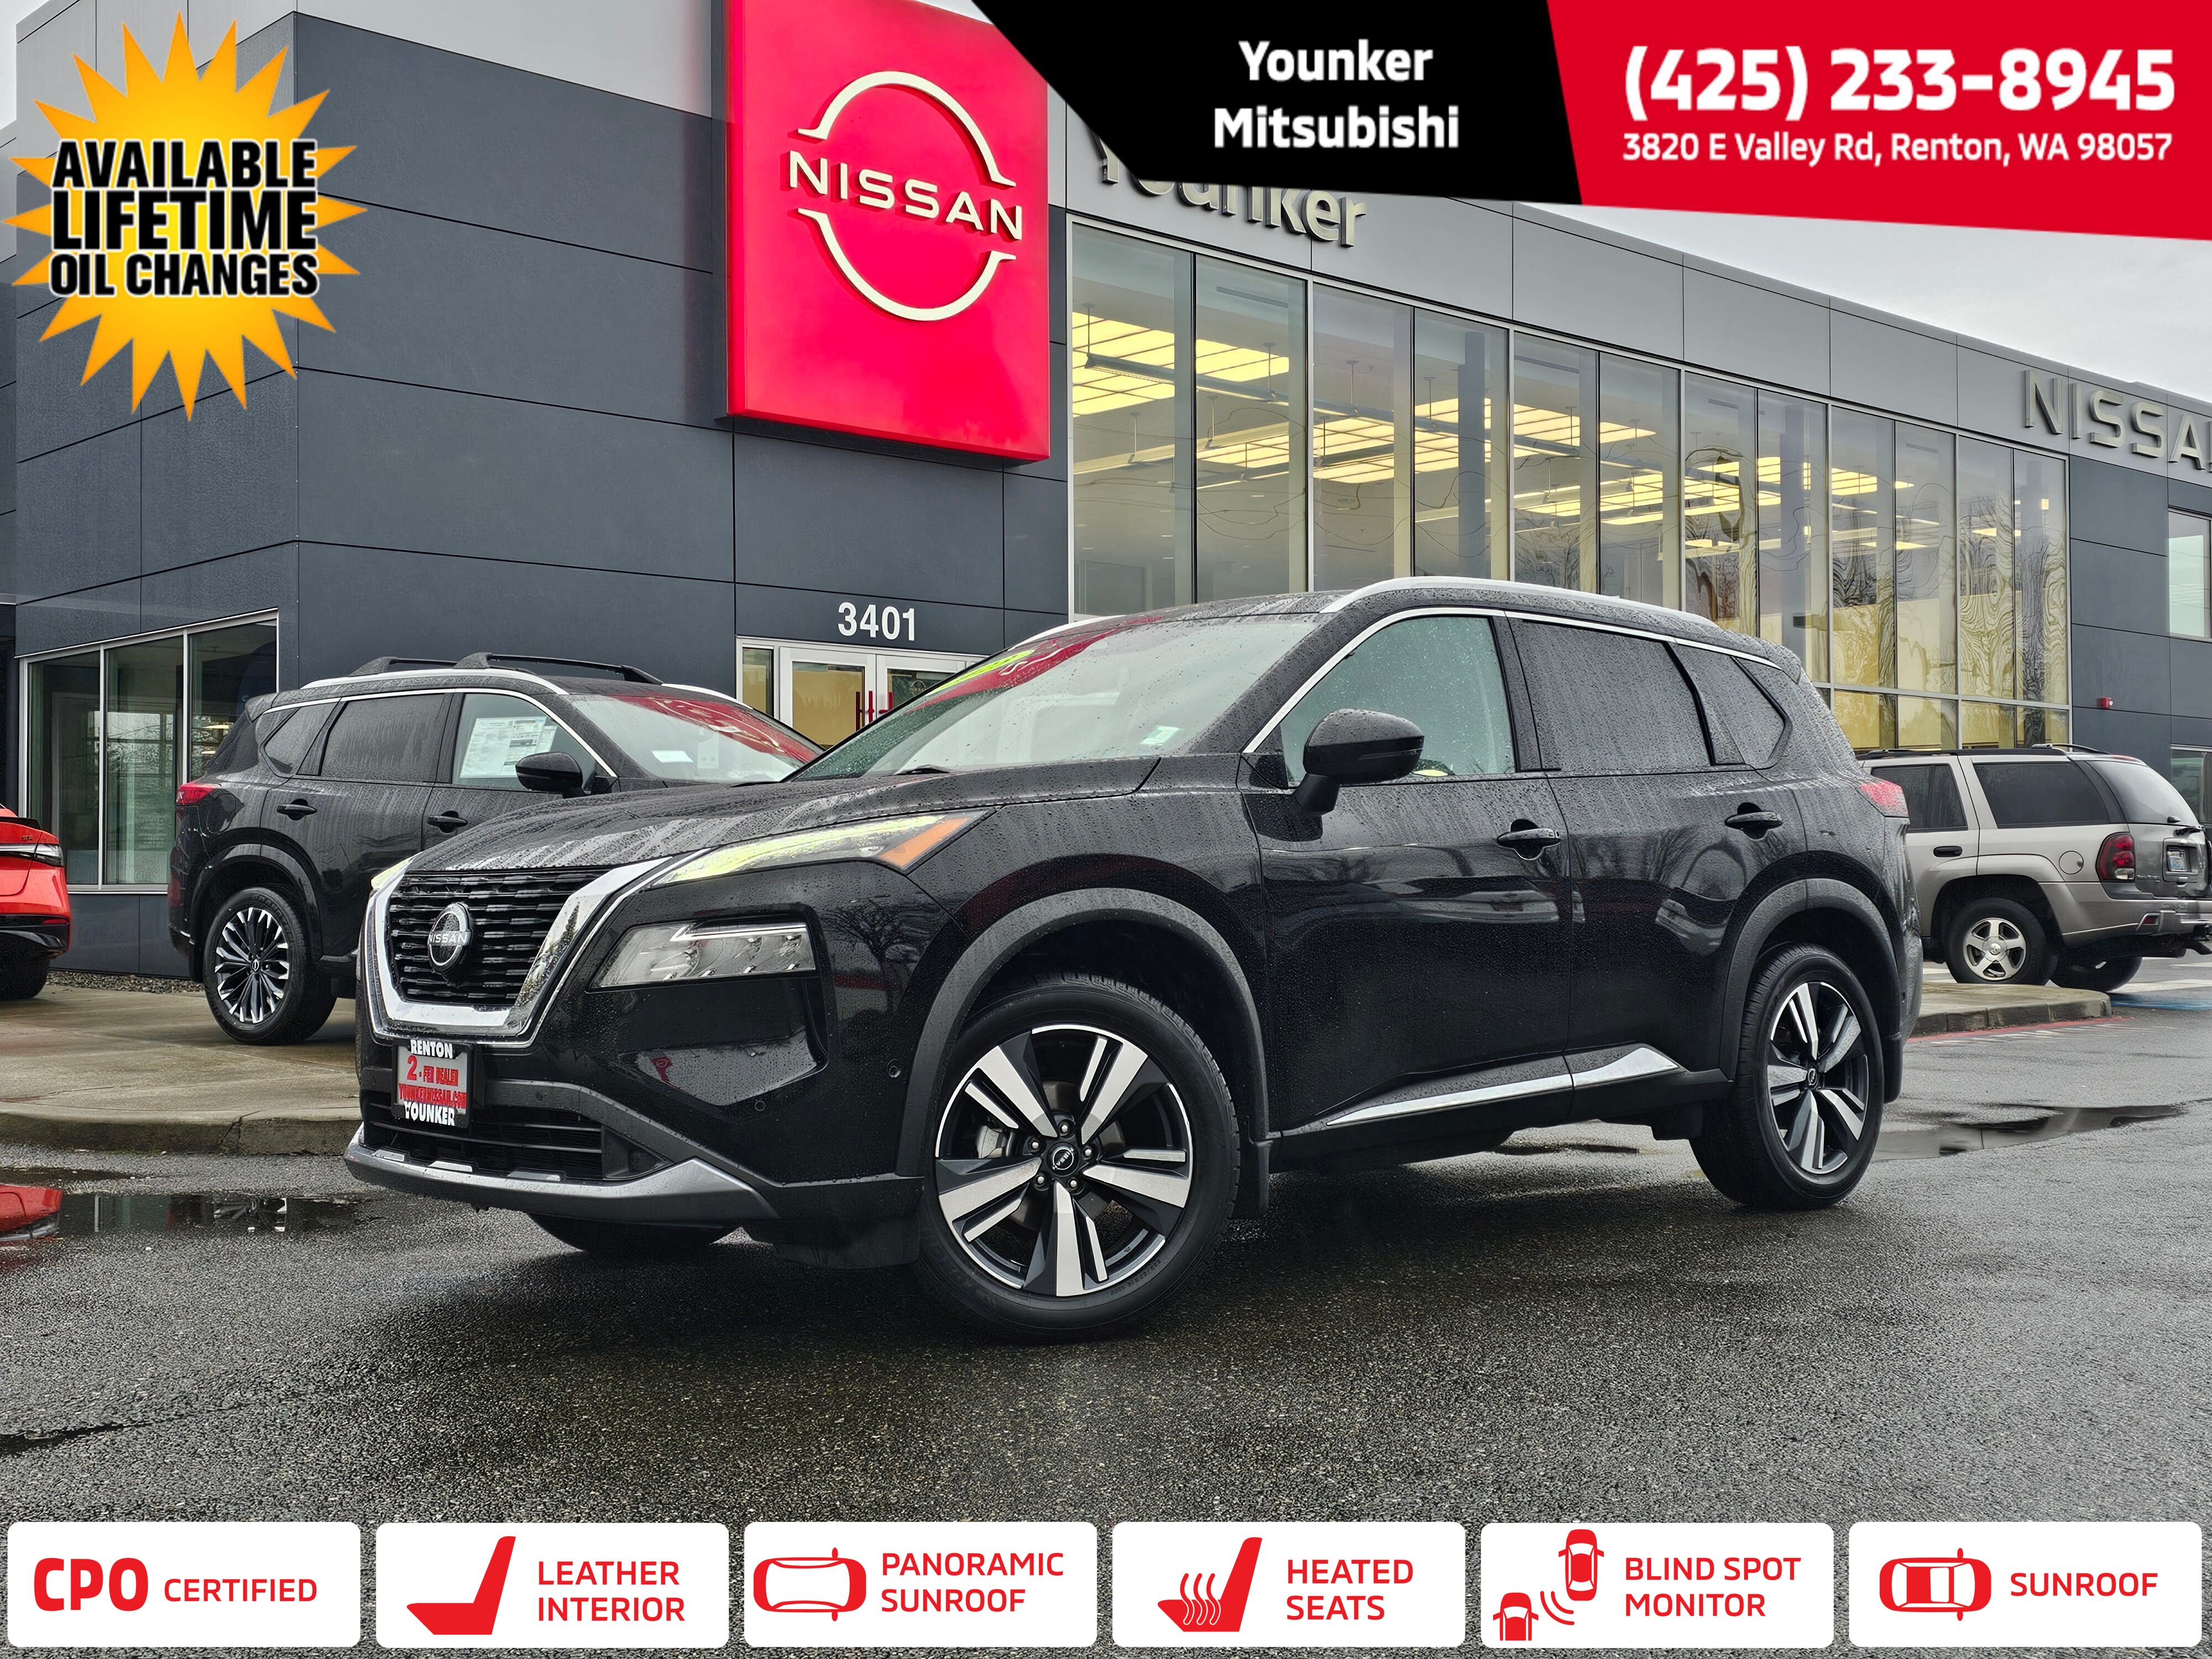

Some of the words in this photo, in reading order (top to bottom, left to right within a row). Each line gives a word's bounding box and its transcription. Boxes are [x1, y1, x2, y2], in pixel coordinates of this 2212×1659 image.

[789, 149, 1022, 240] NISSAN
[2024, 369, 2212, 473] NISSA
[838, 602, 915, 641] 3401
[429, 933, 467, 943] NISSAN
[410, 1039, 453, 1059] RENTON
[406, 1055, 418, 1081] 2
[404, 1101, 455, 1126] YOUNKER
